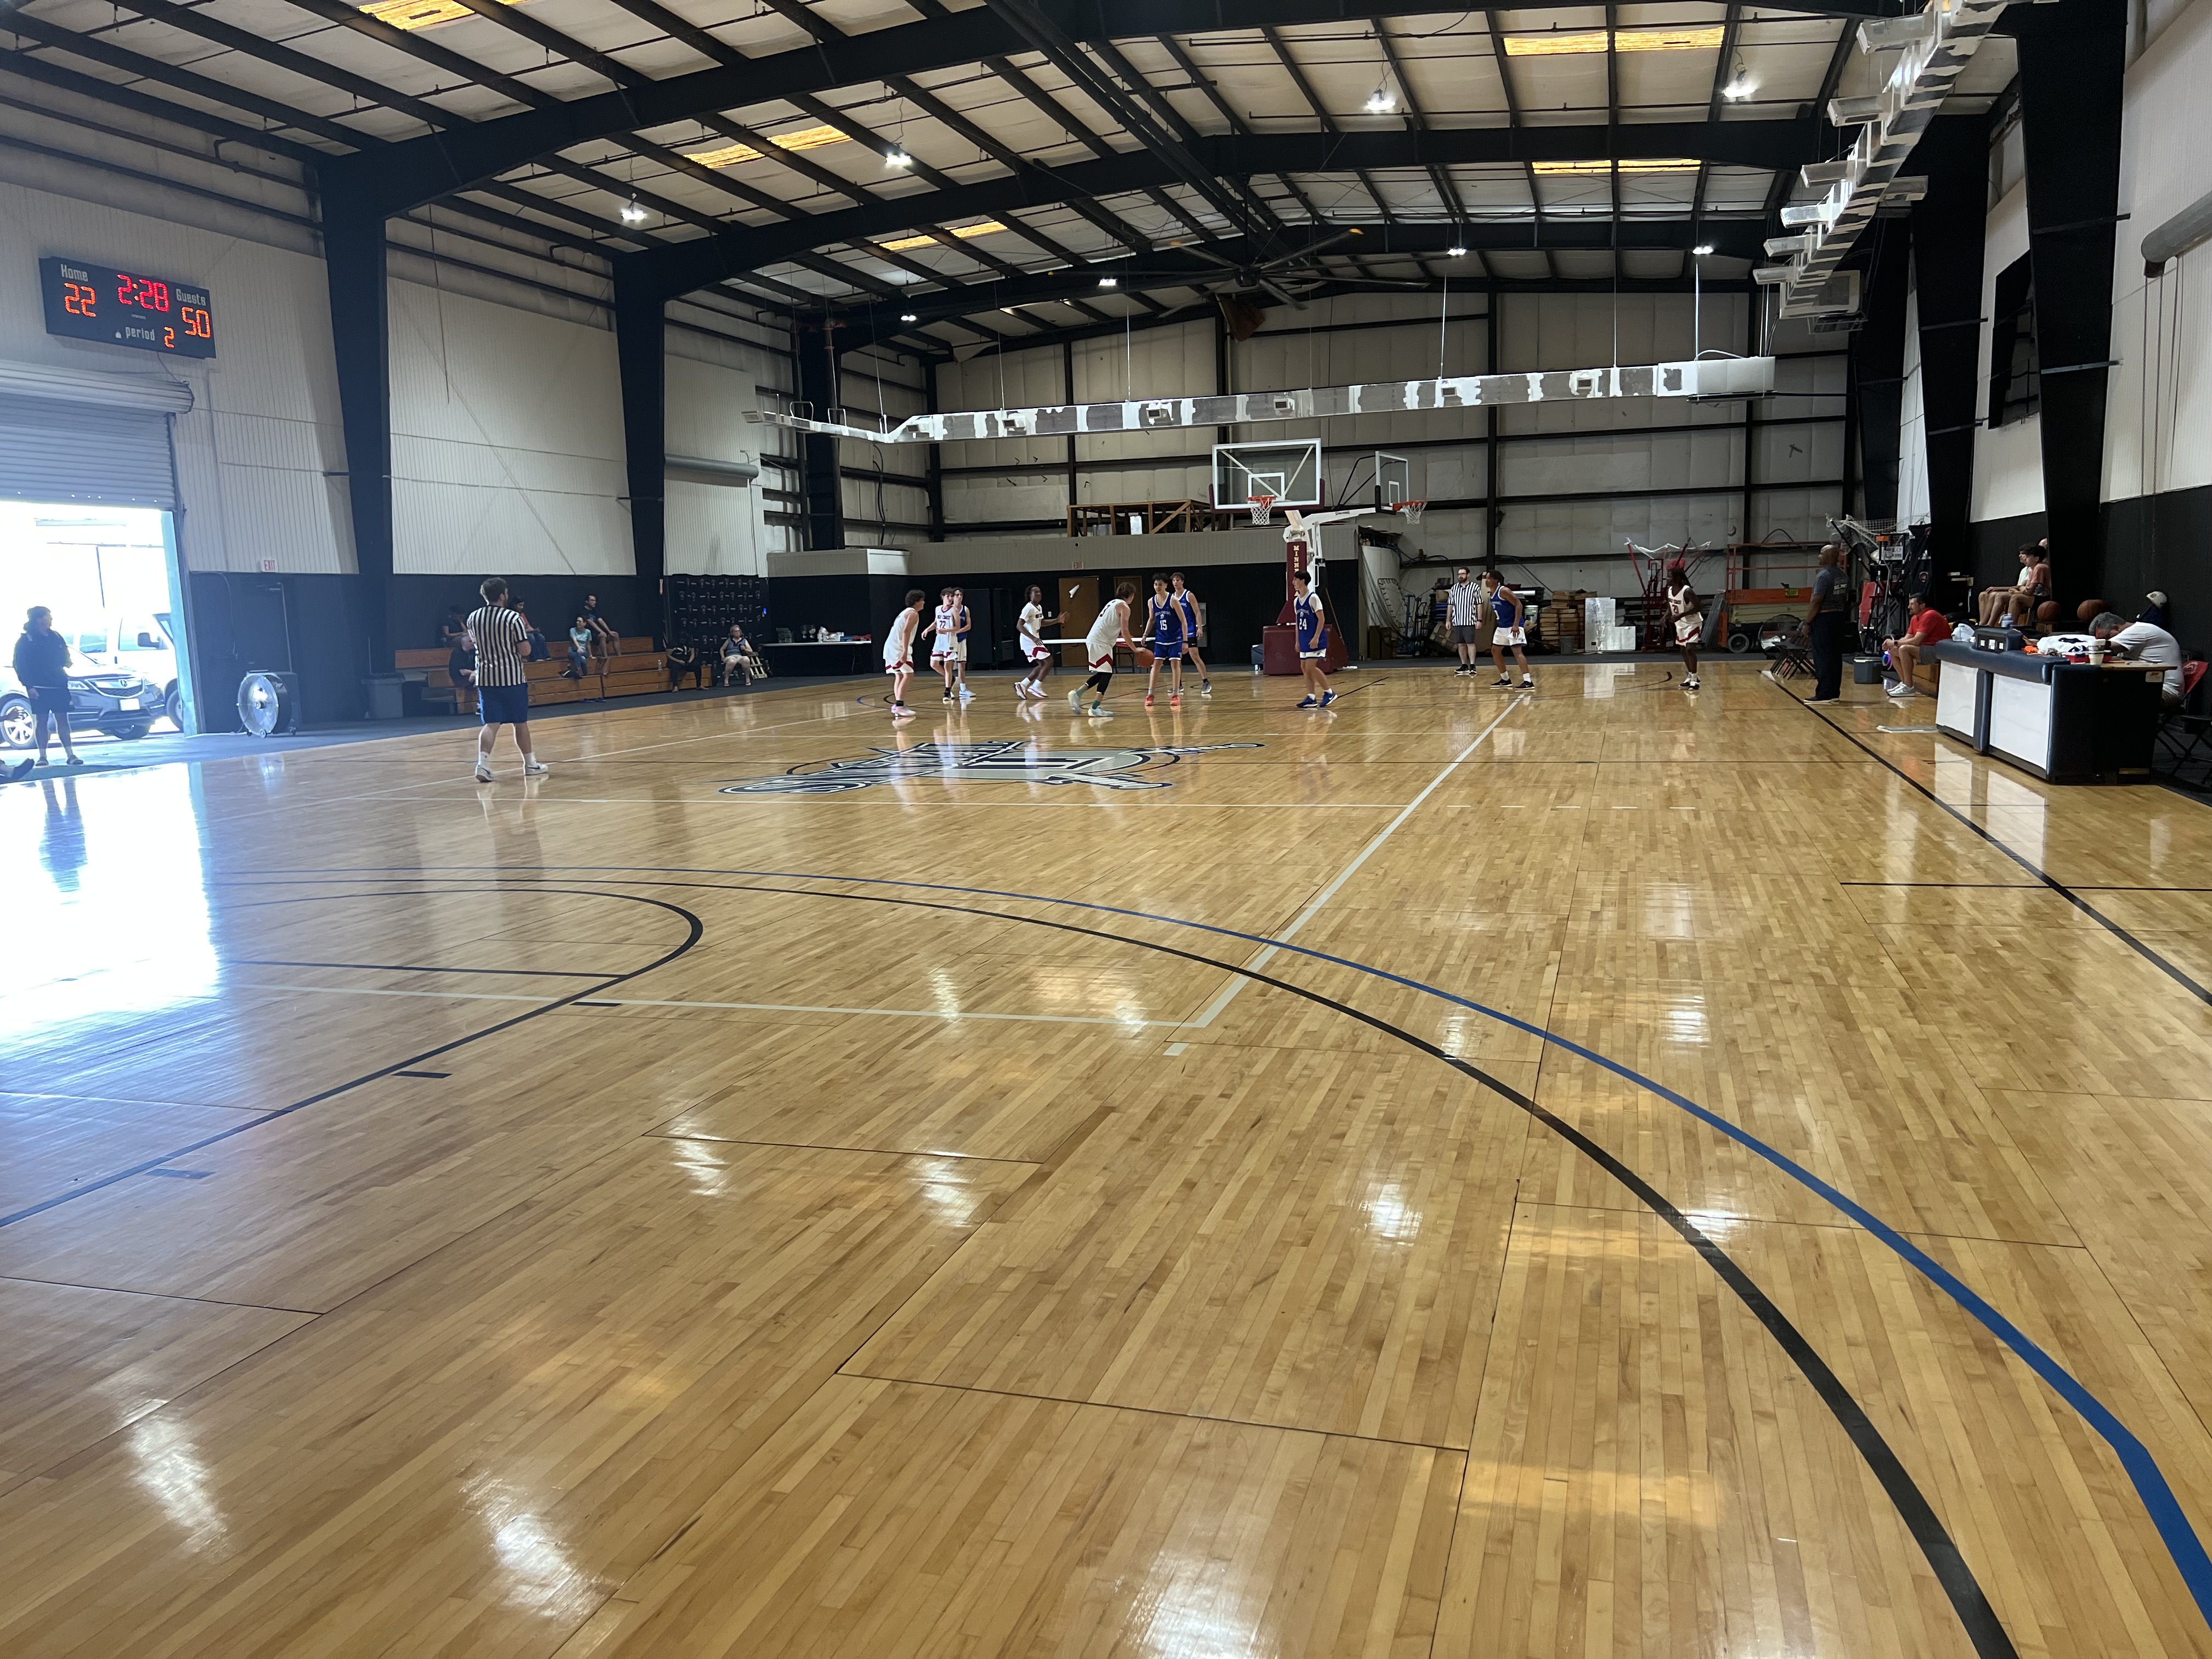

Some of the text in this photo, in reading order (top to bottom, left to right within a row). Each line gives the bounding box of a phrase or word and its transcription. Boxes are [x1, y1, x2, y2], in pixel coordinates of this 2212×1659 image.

[60, 263, 88, 282] Home
[64, 282, 97, 317] 22
[117, 274, 170, 312] 2:28
[176, 288, 206, 306] Guests
[182, 307, 211, 338] 50
[125, 326, 155, 341] period
[164, 326, 175, 348] 2
[263, 560, 276, 571] EXIT
[1160, 619, 1168, 630] 15
[1299, 618, 1307, 630] 24
